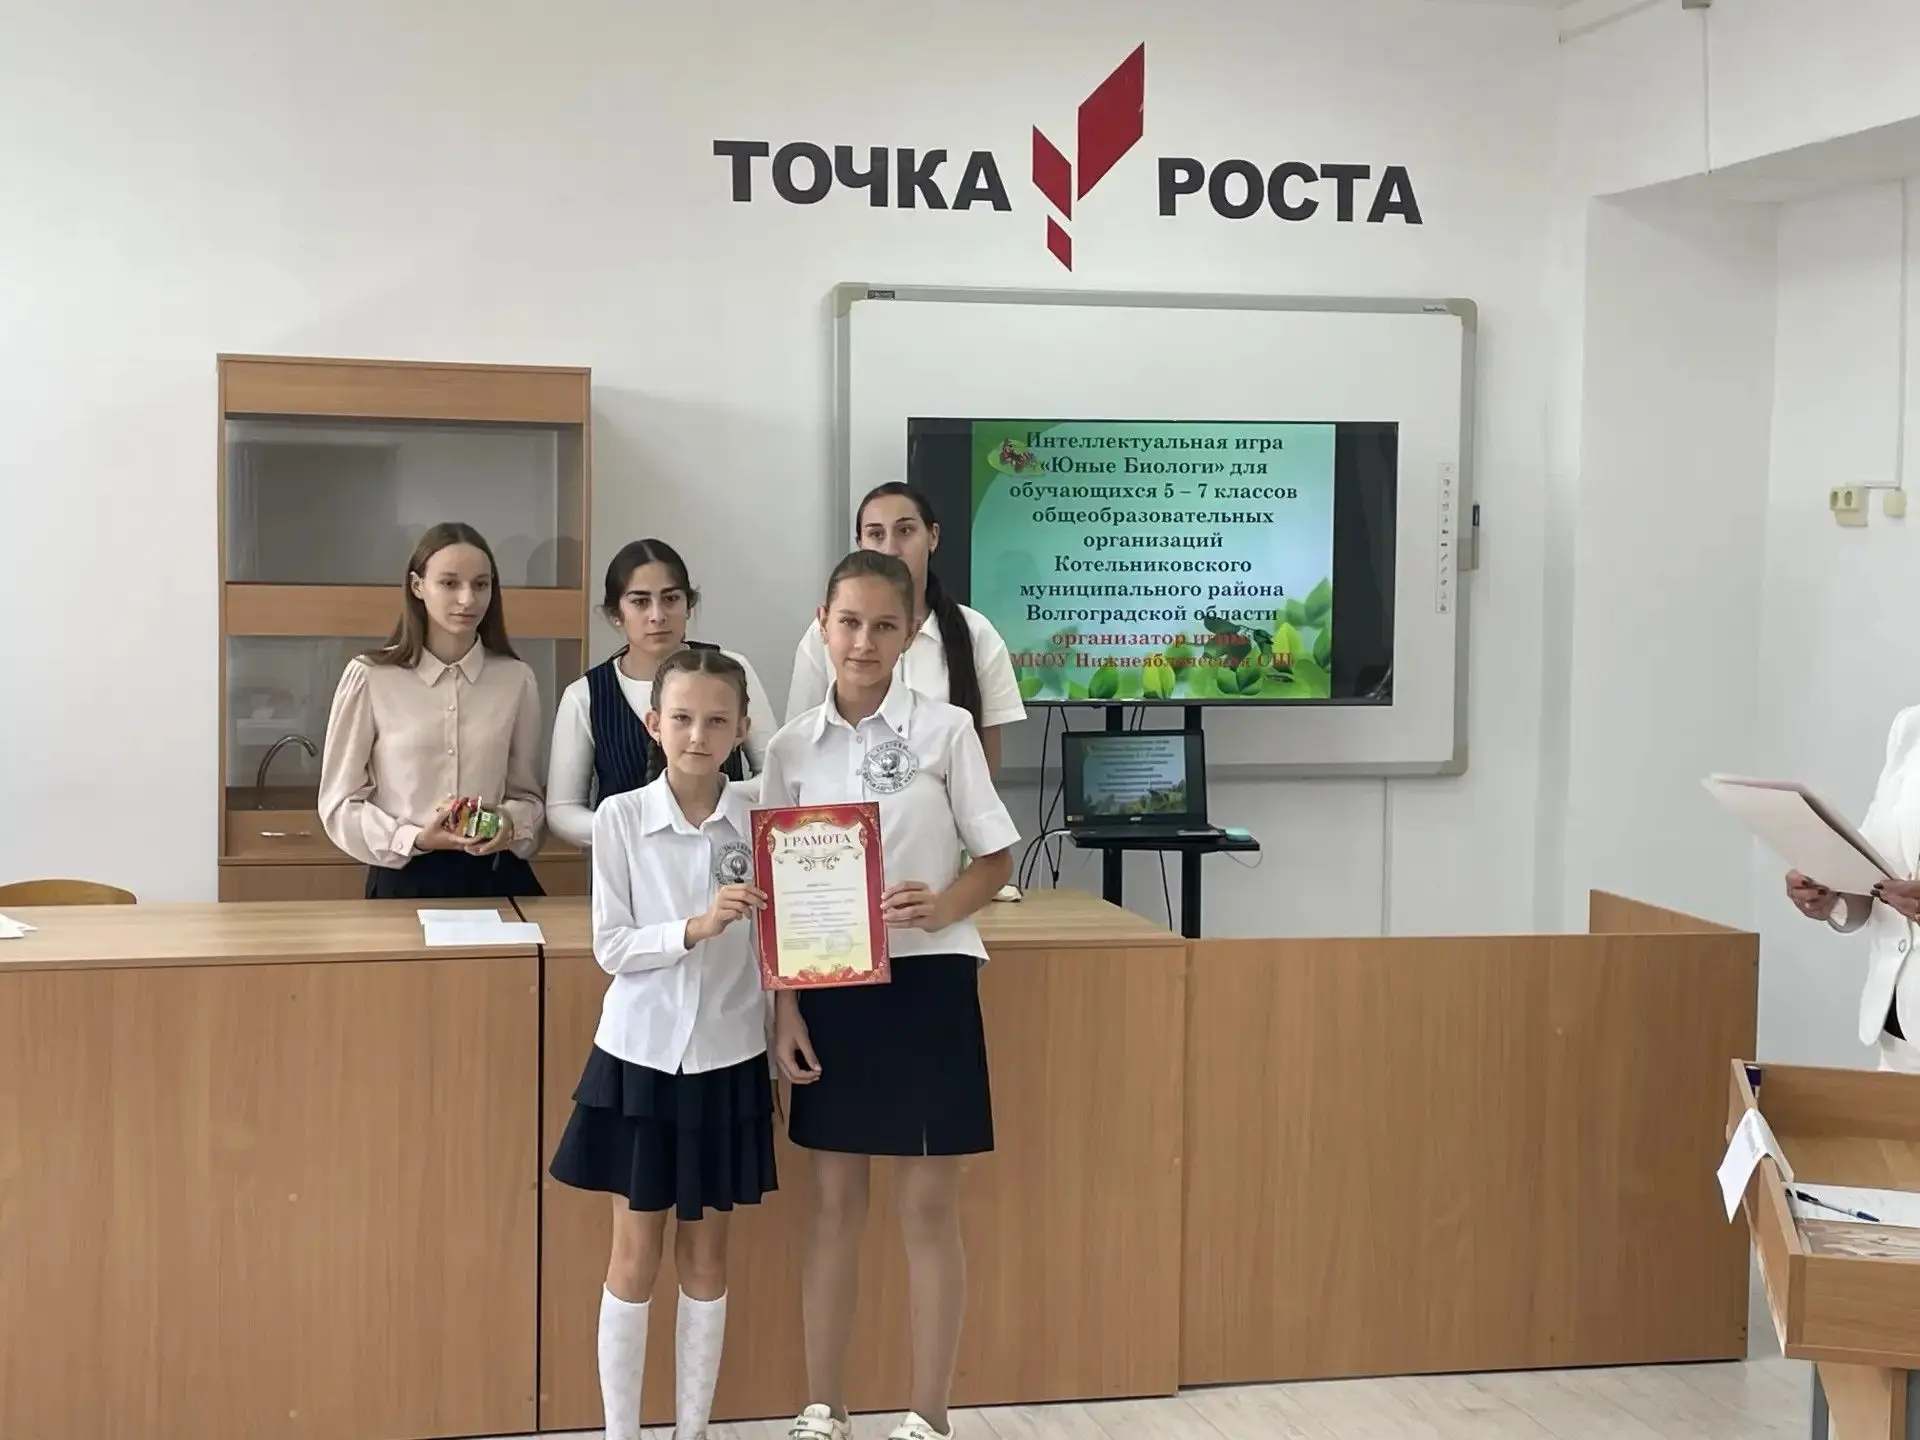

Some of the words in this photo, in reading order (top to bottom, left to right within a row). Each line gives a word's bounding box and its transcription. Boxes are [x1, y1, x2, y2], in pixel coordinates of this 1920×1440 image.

[713, 139, 1012, 212] ТОЧКА
[1158, 157, 1423, 225] РОСТА
[1025, 431, 1228, 453] Интеллектуальная
[1235, 436, 1284, 453] игра
[1040, 457, 1117, 475] «Юные
[1123, 456, 1225, 476] Биологи»
[1229, 463, 1268, 479] для
[1009, 482, 1158, 502] обучающихся
[1164, 483, 1175, 499] 5
[1198, 483, 1209, 499] 7
[1213, 485, 1298, 501] классов
[1032, 505, 1275, 527] общеобразовательных
[1083, 531, 1224, 553] организаций
[1054, 554, 1252, 577] Котельниковского
[1019, 582, 1202, 602] муниципального
[1208, 580, 1286, 602] района
[1026, 602, 1187, 625] Волгоградской
[1193, 604, 1279, 622] области
[1051, 630, 1186, 648] организатор
[1011, 652, 1066, 667] МКОУ
[784, 833, 852, 848] ГРАМОТА
